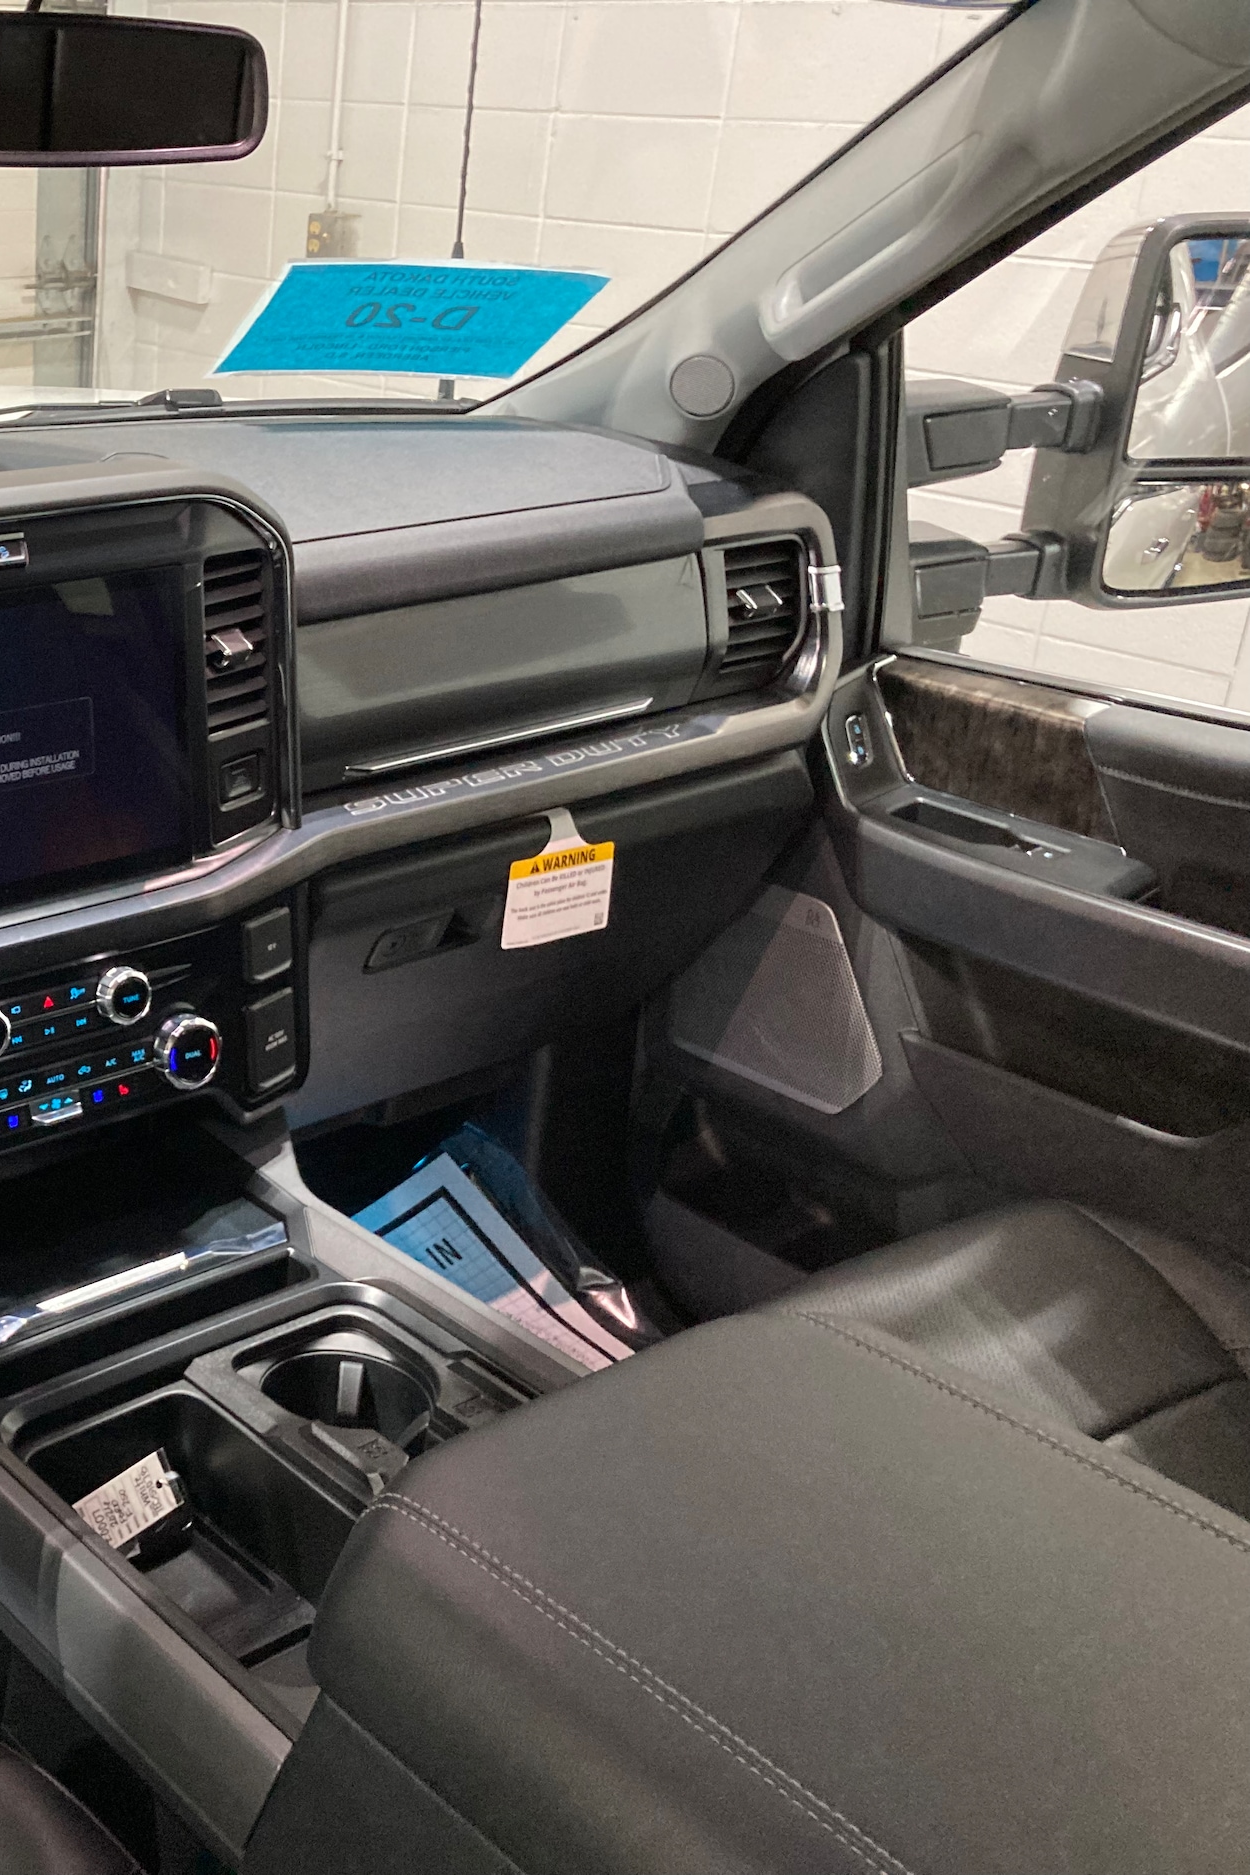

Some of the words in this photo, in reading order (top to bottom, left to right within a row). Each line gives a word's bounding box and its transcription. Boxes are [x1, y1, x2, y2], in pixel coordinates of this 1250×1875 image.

[1, 760, 29, 774] DURING
[29, 750, 80, 769] INSTALLATION
[22, 766, 51, 779] BEFORE
[51, 760, 77, 774] USAGE
[343, 760, 543, 816] SUPER
[547, 723, 682, 767] DUTY
[543, 848, 596, 871] WARNING
[122, 994, 140, 1004] TUNE
[105, 1058, 117, 1067] A/C
[184, 1049, 203, 1060] DUAL
[46, 1073, 65, 1085] AUTO
[425, 1238, 463, 1270] IN
